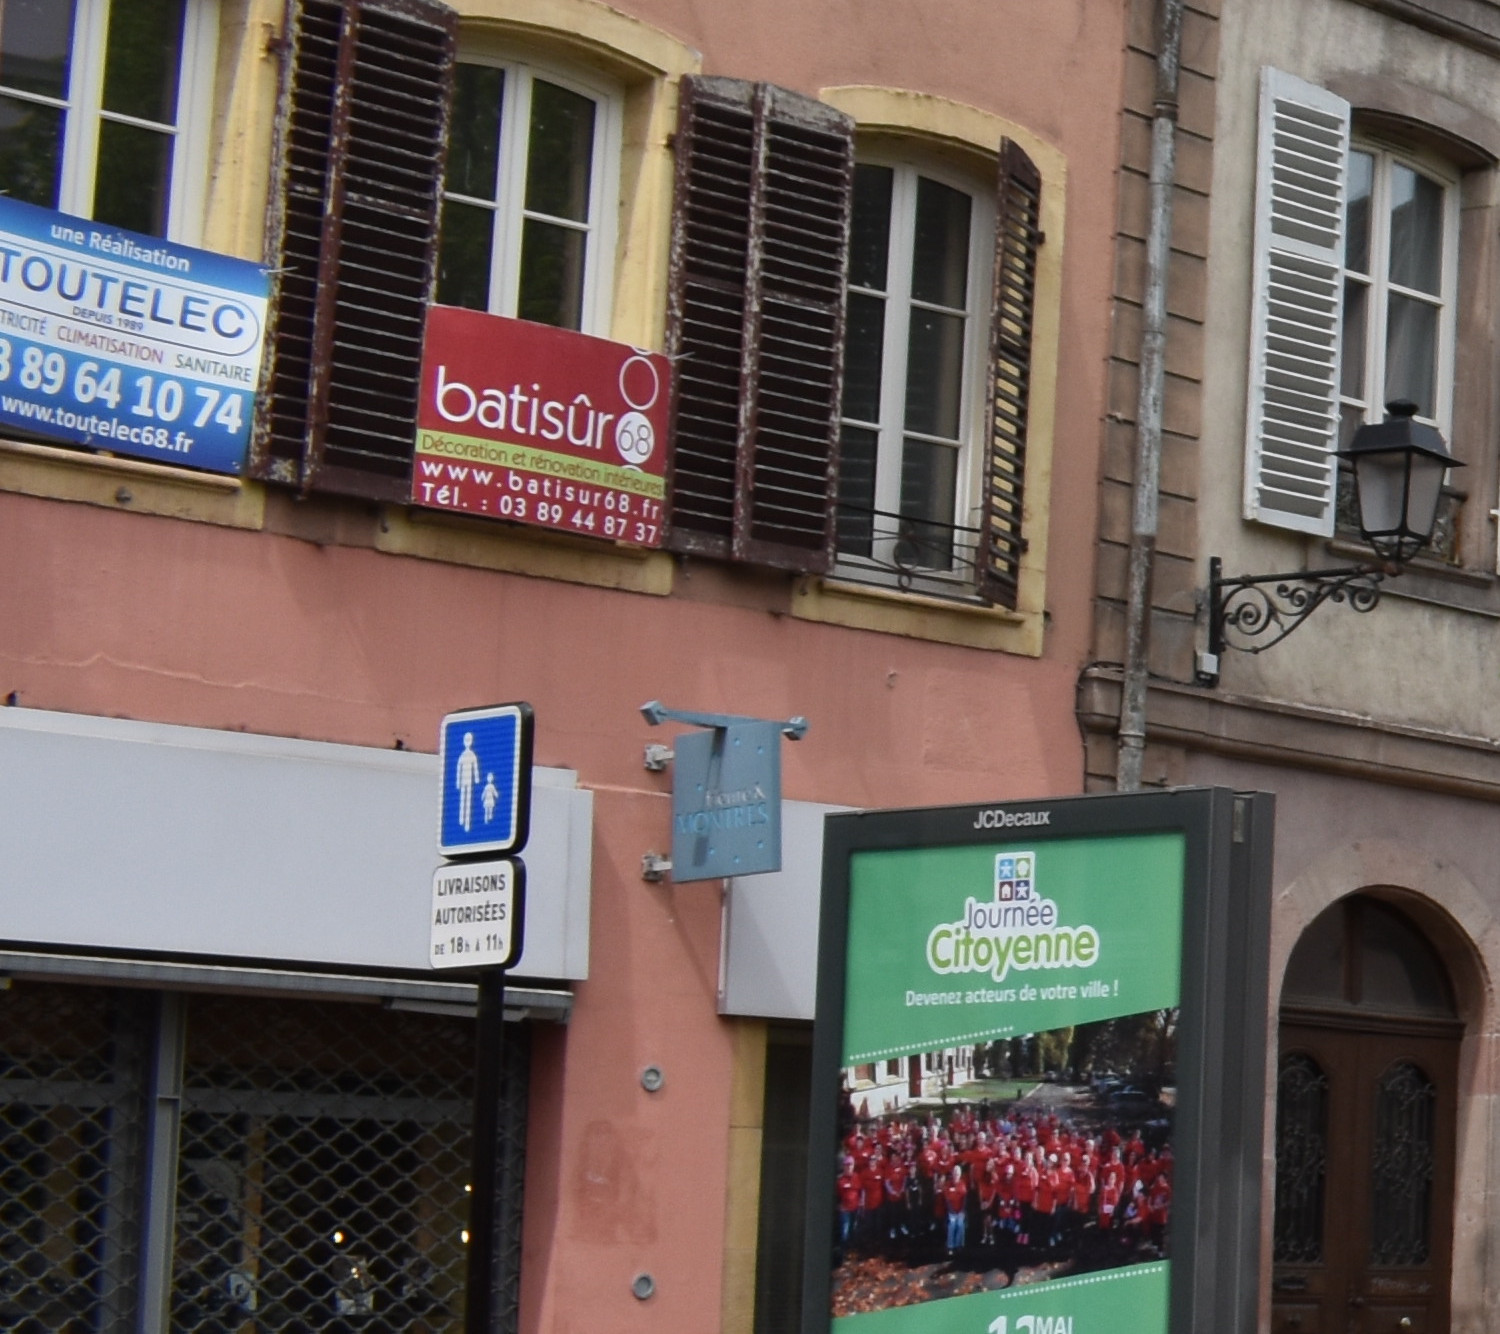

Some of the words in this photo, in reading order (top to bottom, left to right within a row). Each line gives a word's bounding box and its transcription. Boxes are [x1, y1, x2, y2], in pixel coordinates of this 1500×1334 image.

[51, 224, 84, 245] une
[89, 230, 190, 272] Réalisation
[0, 246, 245, 338] TOUTELEC
[72, 305, 113, 324] DEPUIS
[117, 317, 144, 331] 1989
[57, 325, 163, 364] CLIMATISATION
[175, 353, 252, 383] SANITAIRE
[20, 346, 66, 395] 89
[74, 361, 121, 409] 64
[131, 375, 183, 422] 10
[194, 386, 243, 434] 74
[436, 365, 614, 450] batisûr
[618, 420, 651, 456] 68
[2, 395, 194, 453] www.toutelec68.fr
[421, 460, 659, 520] www.batisur68.fr
[422, 434, 508, 464] Décoration
[512, 452, 526, 467] et
[530, 453, 600, 480] rénovation
[604, 469, 662, 497] intérieures
[422, 482, 468, 508] Tél.
[500, 495, 527, 517] 03
[537, 501, 563, 522] 89
[571, 509, 595, 530] 44
[604, 516, 627, 536] 87
[635, 522, 657, 543] 37
[974, 809, 1051, 829] JCDecaux
[437, 873, 506, 896] LIVRAISONS
[435, 900, 506, 925] AUTORISÉES
[963, 898, 1053, 930] Journée
[434, 943, 445, 955] DE
[931, 927, 1096, 976] Citoyenne
[906, 990, 961, 1006] Devenez
[965, 988, 1016, 1003] acteurs
[1020, 985, 1036, 1001] de
[1040, 984, 1076, 999] votre
[1081, 980, 1110, 998] ville
